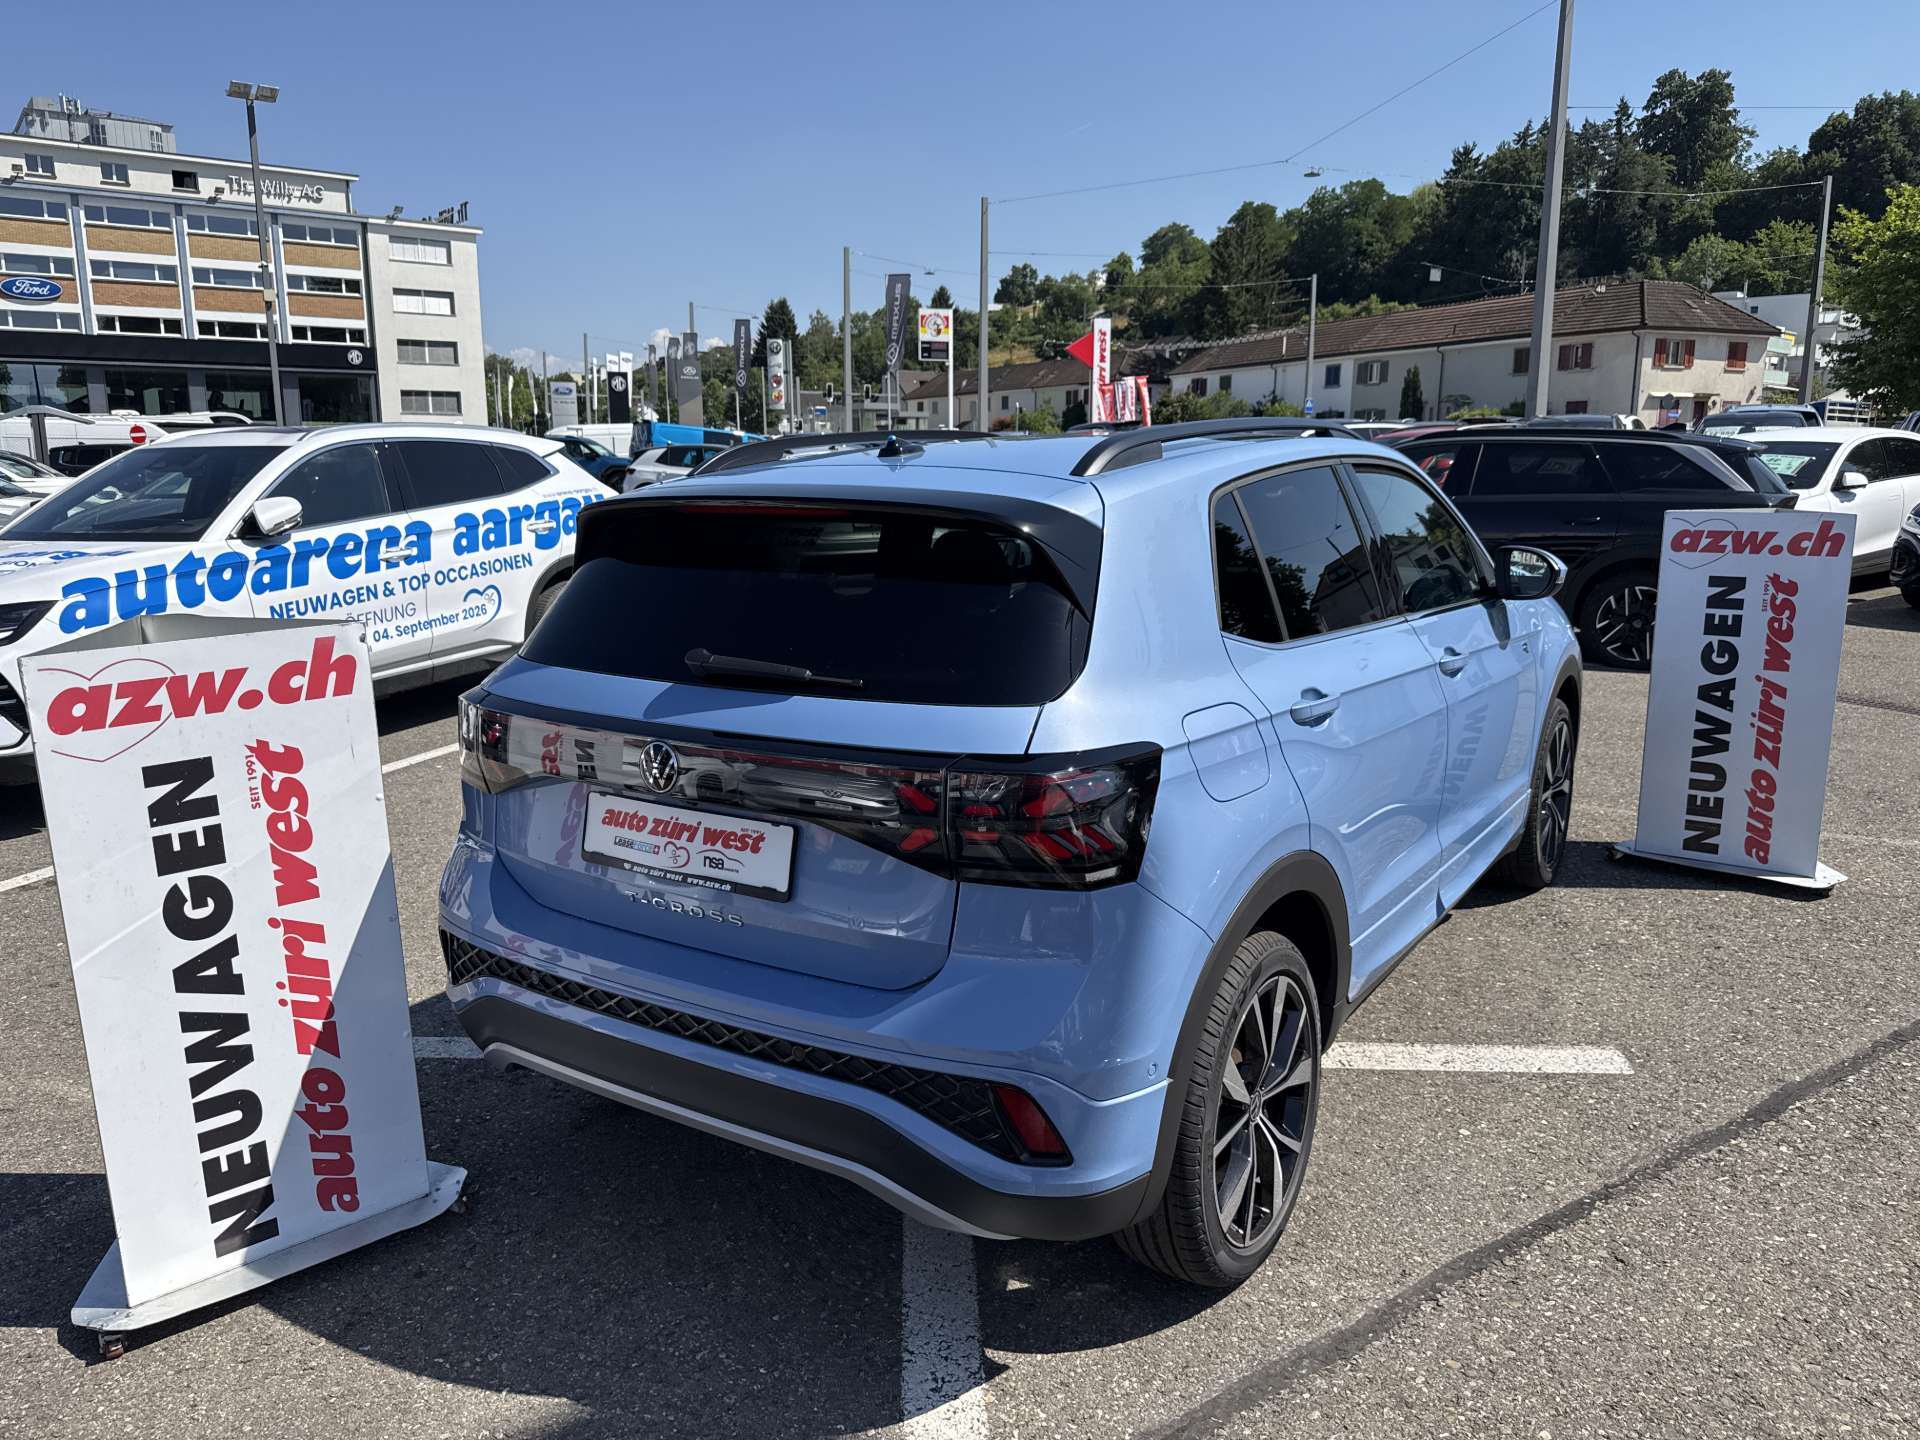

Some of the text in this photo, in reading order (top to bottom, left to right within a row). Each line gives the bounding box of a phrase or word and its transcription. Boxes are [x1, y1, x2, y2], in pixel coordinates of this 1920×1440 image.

[12, 279, 51, 295] Ford
[610, 375, 627, 393] MG
[1669, 520, 1846, 558] azw.ch
[58, 520, 432, 635] autoarena
[268, 552, 534, 619] NEUWAGEN & TOP OCCASIONEN
[372, 603, 488, 643] 04. September 2026
[46, 635, 358, 736] azw.ch
[1681, 575, 1747, 855] NEUWAGEN
[1743, 573, 1800, 866] auto züri west
[245, 754, 261, 810] SEIT 1991
[602, 808, 766, 854] auto züri west
[703, 855, 725, 871] nsa
[244, 738, 362, 1215] auto züri west
[142, 756, 280, 1260] NEUWAGEN
